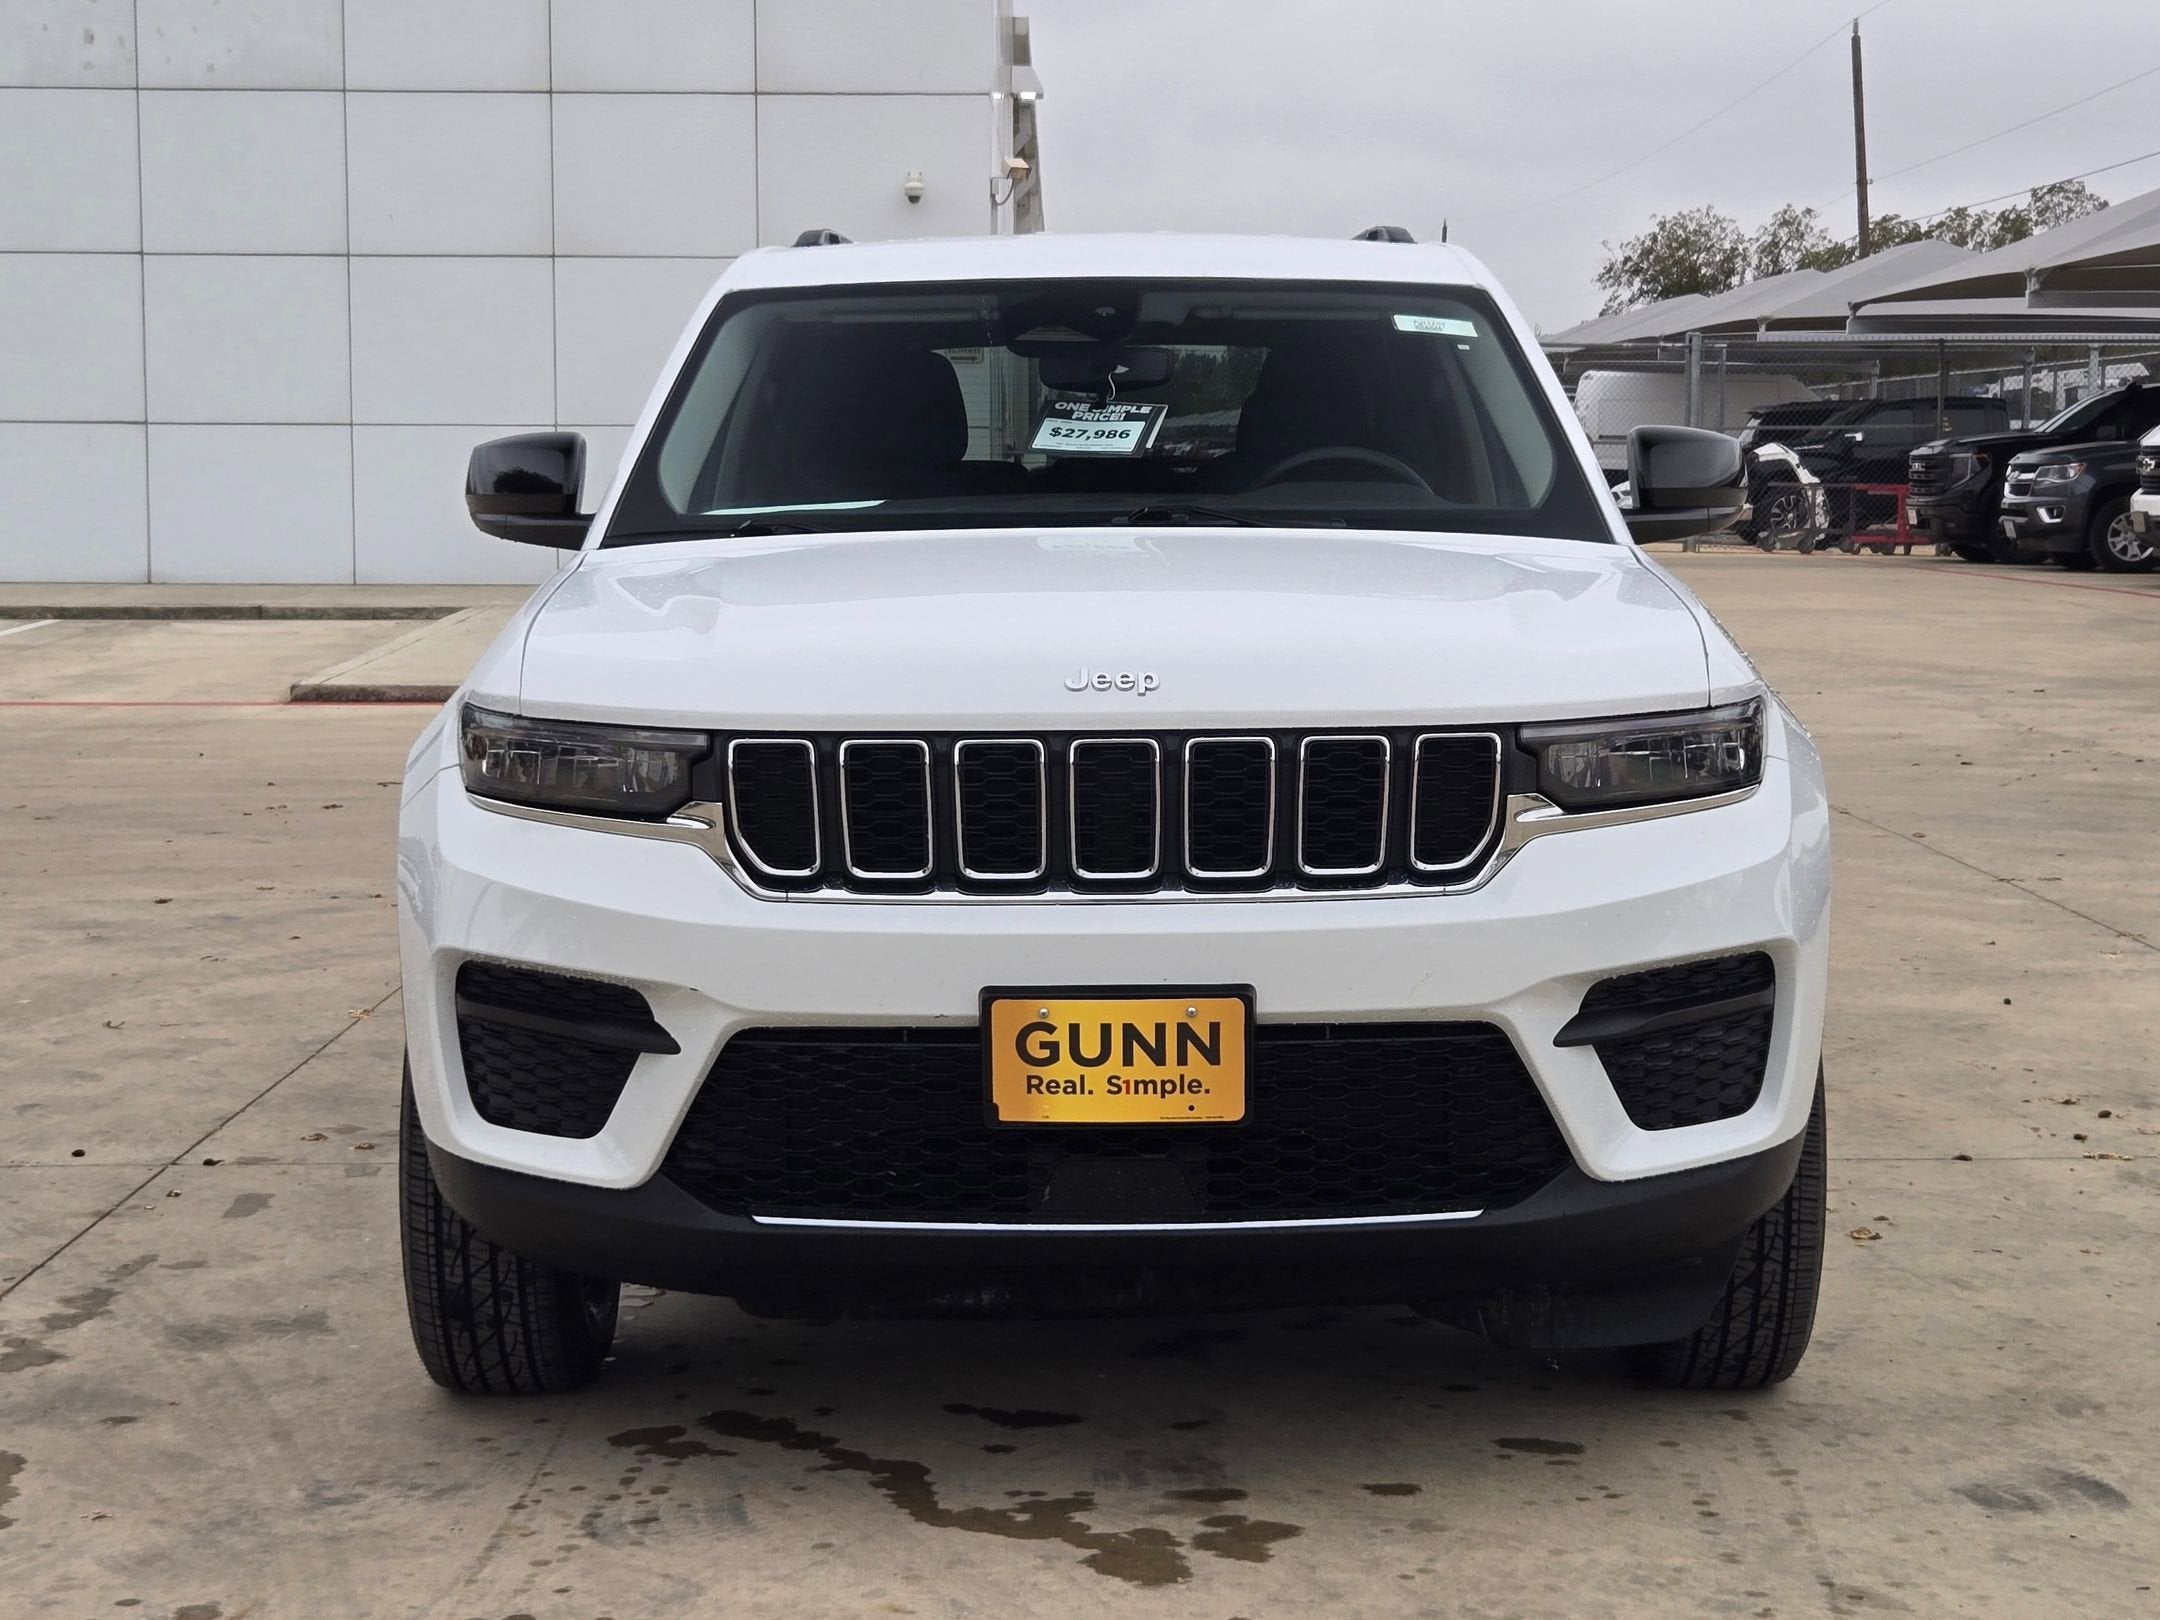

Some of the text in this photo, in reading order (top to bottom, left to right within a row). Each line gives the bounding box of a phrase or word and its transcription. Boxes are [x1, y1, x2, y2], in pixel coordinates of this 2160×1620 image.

[1055, 402, 1152, 413] ONE IMPLE
[1072, 411, 1126, 420] PRICE!
[1049, 427, 1131, 440] $27,986
[1064, 667, 1160, 696] Jeep
[1015, 1021, 1221, 1067] GUNN
[1026, 1074, 1094, 1095] Real.
